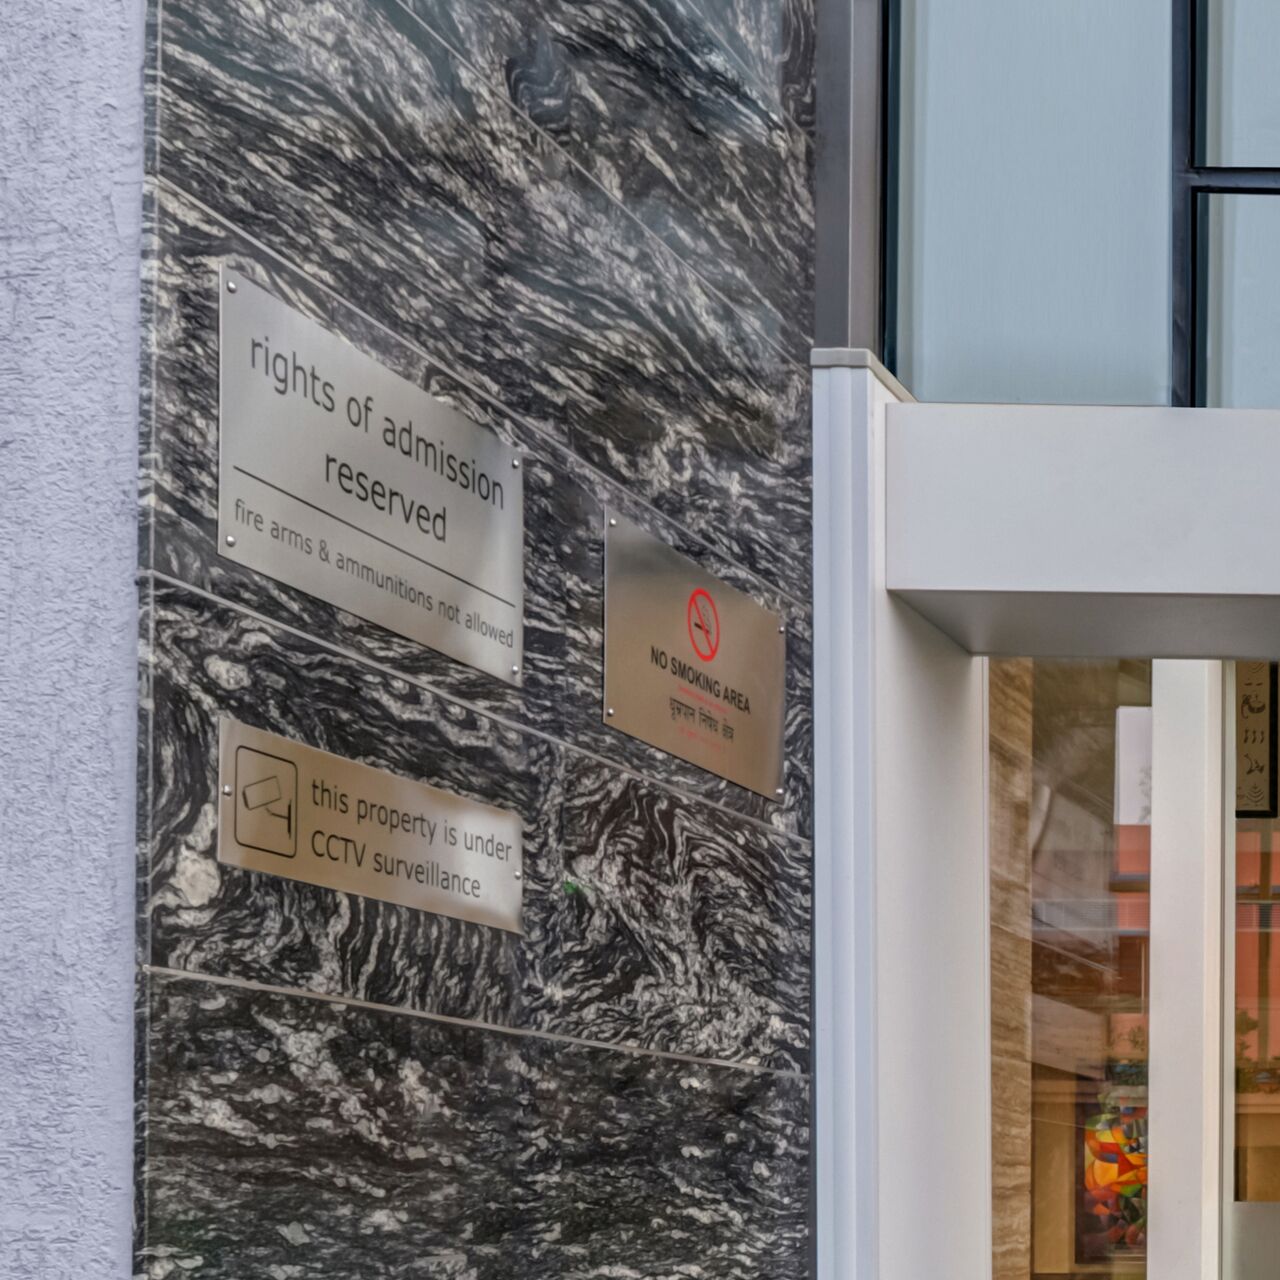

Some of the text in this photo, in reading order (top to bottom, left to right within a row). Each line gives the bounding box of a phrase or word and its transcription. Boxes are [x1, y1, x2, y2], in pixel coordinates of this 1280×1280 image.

[250, 336, 504, 509] rights of admission
[325, 453, 447, 543] reserved
[234, 498, 514, 648] fire arms & ammunitions not allowed
[650, 645, 668, 670] NO
[670, 656, 721, 698] SMOKING
[722, 686, 751, 715] AREA
[311, 779, 513, 862] this property is under
[311, 829, 481, 898] CCTV surveillance
